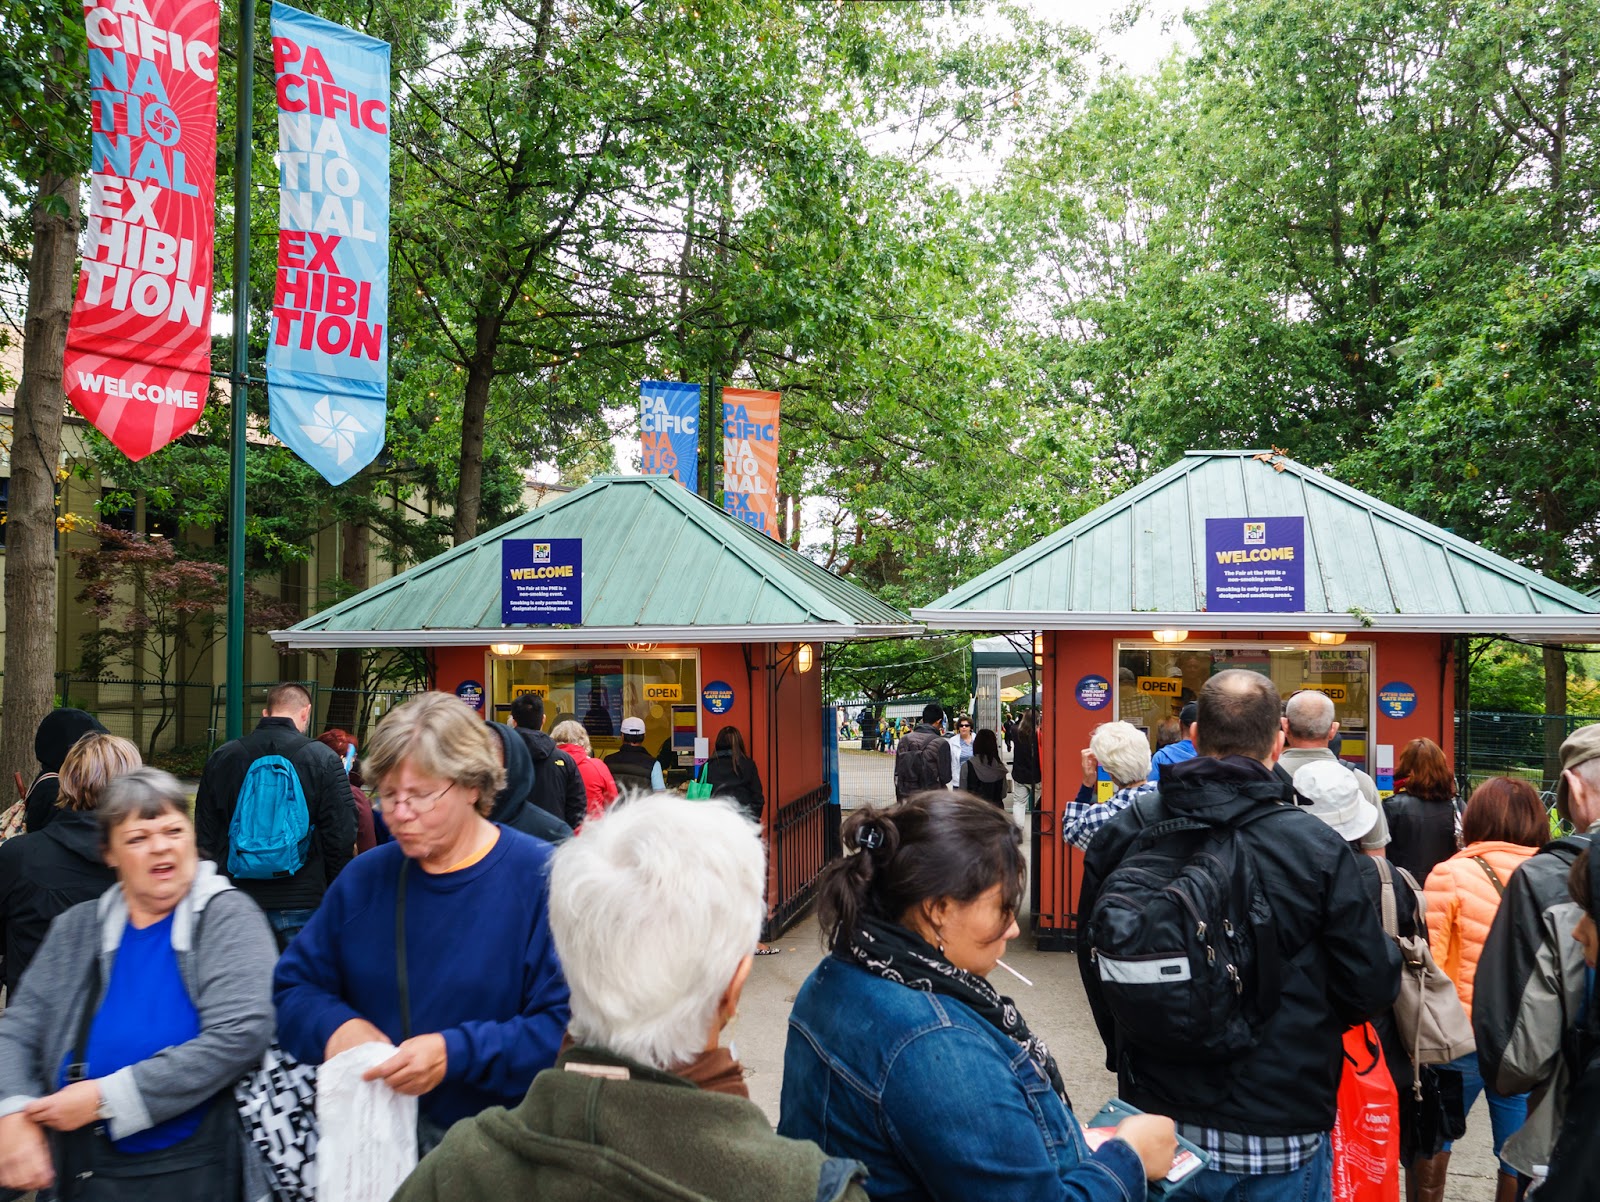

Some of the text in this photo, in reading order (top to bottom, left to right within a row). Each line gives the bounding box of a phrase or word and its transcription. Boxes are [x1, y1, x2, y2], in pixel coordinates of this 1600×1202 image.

[83, 0, 154, 25] A
[85, 6, 215, 82] CIFIC
[273, 36, 335, 84] PA
[89, 49, 170, 106] NA
[275, 74, 387, 134] CIFIC
[278, 113, 349, 160] NA
[91, 132, 198, 198] NAL
[280, 151, 360, 197] TIO
[91, 174, 162, 229] EX
[279, 191, 376, 243] NAL
[83, 218, 193, 281] HIBI
[279, 229, 341, 274] EX
[81, 259, 206, 327] TION
[274, 268, 372, 320] HIBI
[273, 307, 382, 361] TION
[77, 371, 198, 409] WELCOME
[640, 396, 668, 415] PA
[723, 403, 749, 422] PA
[640, 413, 696, 435] CIFIC
[723, 420, 774, 442] CIFIC
[641, 432, 672, 451] NA
[724, 438, 754, 459] NA
[724, 456, 759, 476] TIO
[724, 474, 767, 494] NAL
[724, 491, 750, 510] EX
[1215, 547, 1294, 564] WELCOME
[510, 566, 573, 580] WELCOME
[648, 688, 678, 698] OPEN
[1142, 681, 1176, 692] OPEN
[712, 699, 722, 707] $5
[1390, 702, 1402, 710] $5
